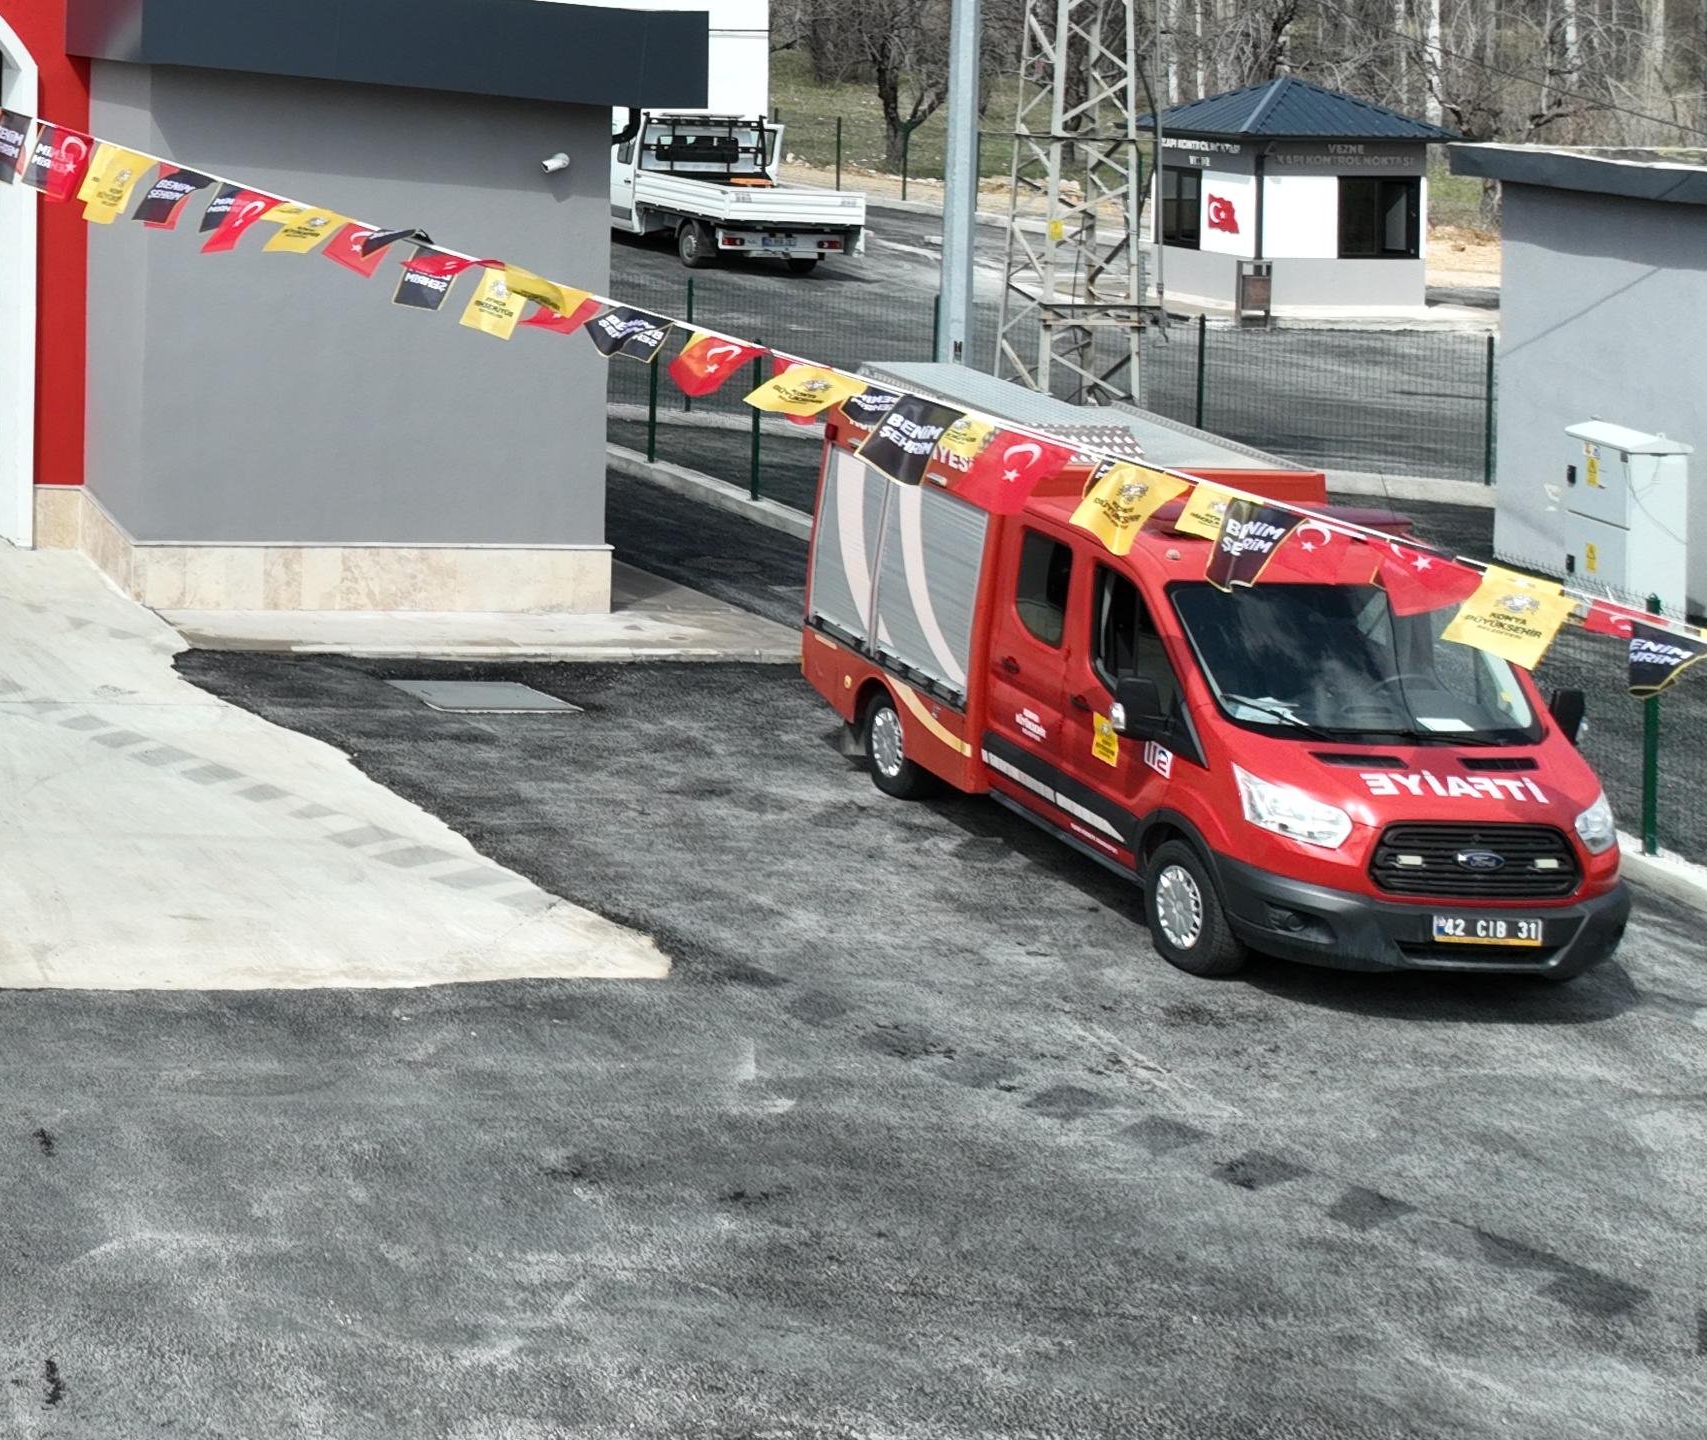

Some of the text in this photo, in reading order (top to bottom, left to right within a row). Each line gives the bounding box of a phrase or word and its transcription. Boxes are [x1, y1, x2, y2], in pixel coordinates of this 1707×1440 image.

[886, 413, 944, 441] BENİM
[878, 425, 935, 455] ŞEHRİM
[1221, 536, 1274, 557] ŞERİM
[1629, 638, 1694, 658] ENİM
[1629, 651, 1683, 666] HRİM
[1444, 919, 1465, 936] 42
[1517, 921, 1537, 939] 31
